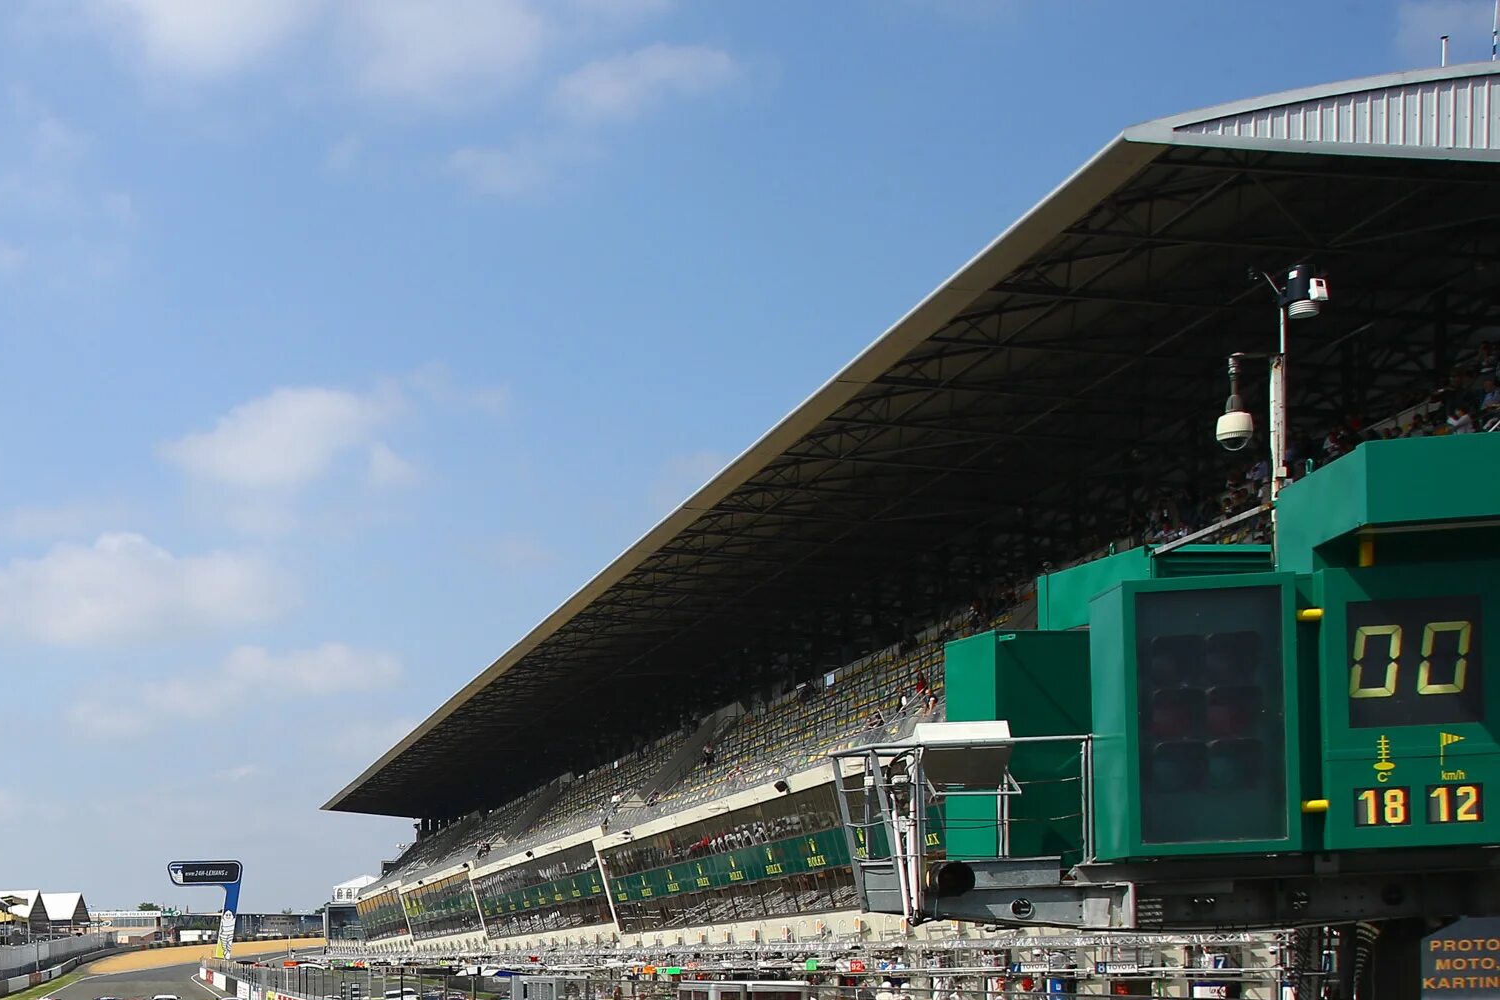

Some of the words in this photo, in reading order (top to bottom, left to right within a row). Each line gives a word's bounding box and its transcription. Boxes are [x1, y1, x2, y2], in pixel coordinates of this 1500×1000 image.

[1441, 770, 1465, 780] km/h
[1358, 789, 1405, 824] 18
[1430, 786, 1478, 821] 12
[851, 962, 861, 970] 92
[1216, 956, 1225, 969] 7
[1423, 977, 1500, 990] KARTIN
